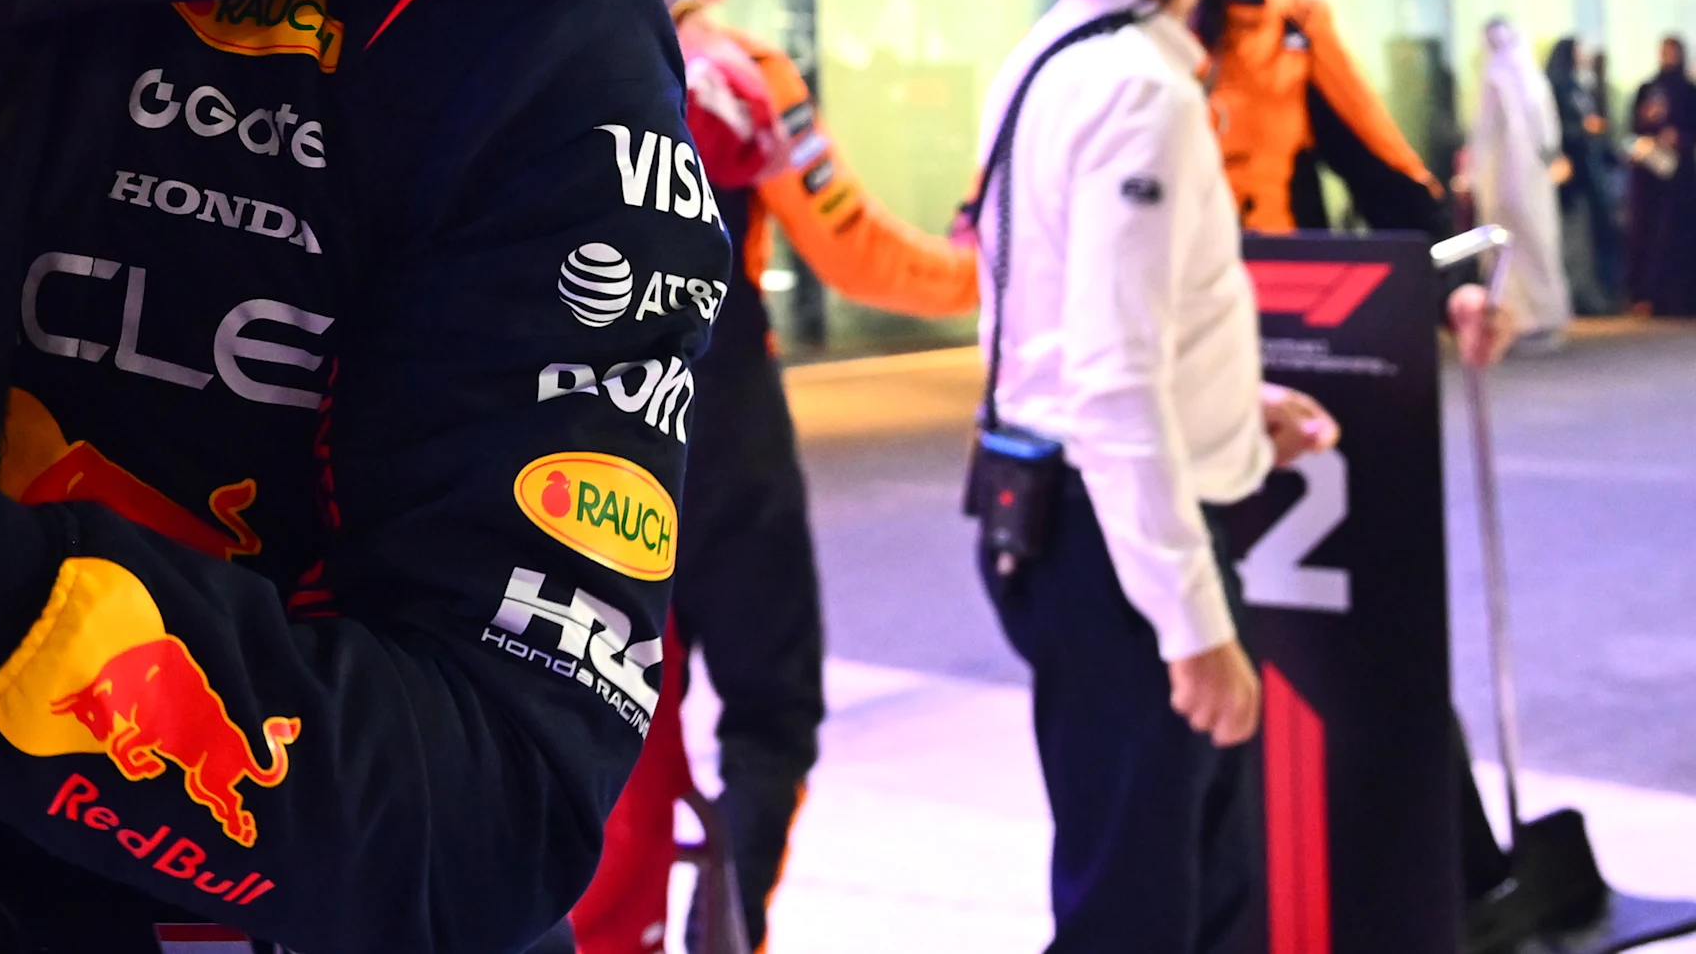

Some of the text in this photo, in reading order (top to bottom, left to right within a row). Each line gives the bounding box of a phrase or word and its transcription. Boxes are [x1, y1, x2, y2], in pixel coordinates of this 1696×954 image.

[108, 170, 323, 254] HONDA
[594, 124, 724, 231] VISA
[577, 480, 673, 560] RAUCH
[1232, 448, 1350, 613] 2
[481, 627, 594, 689] Honda
